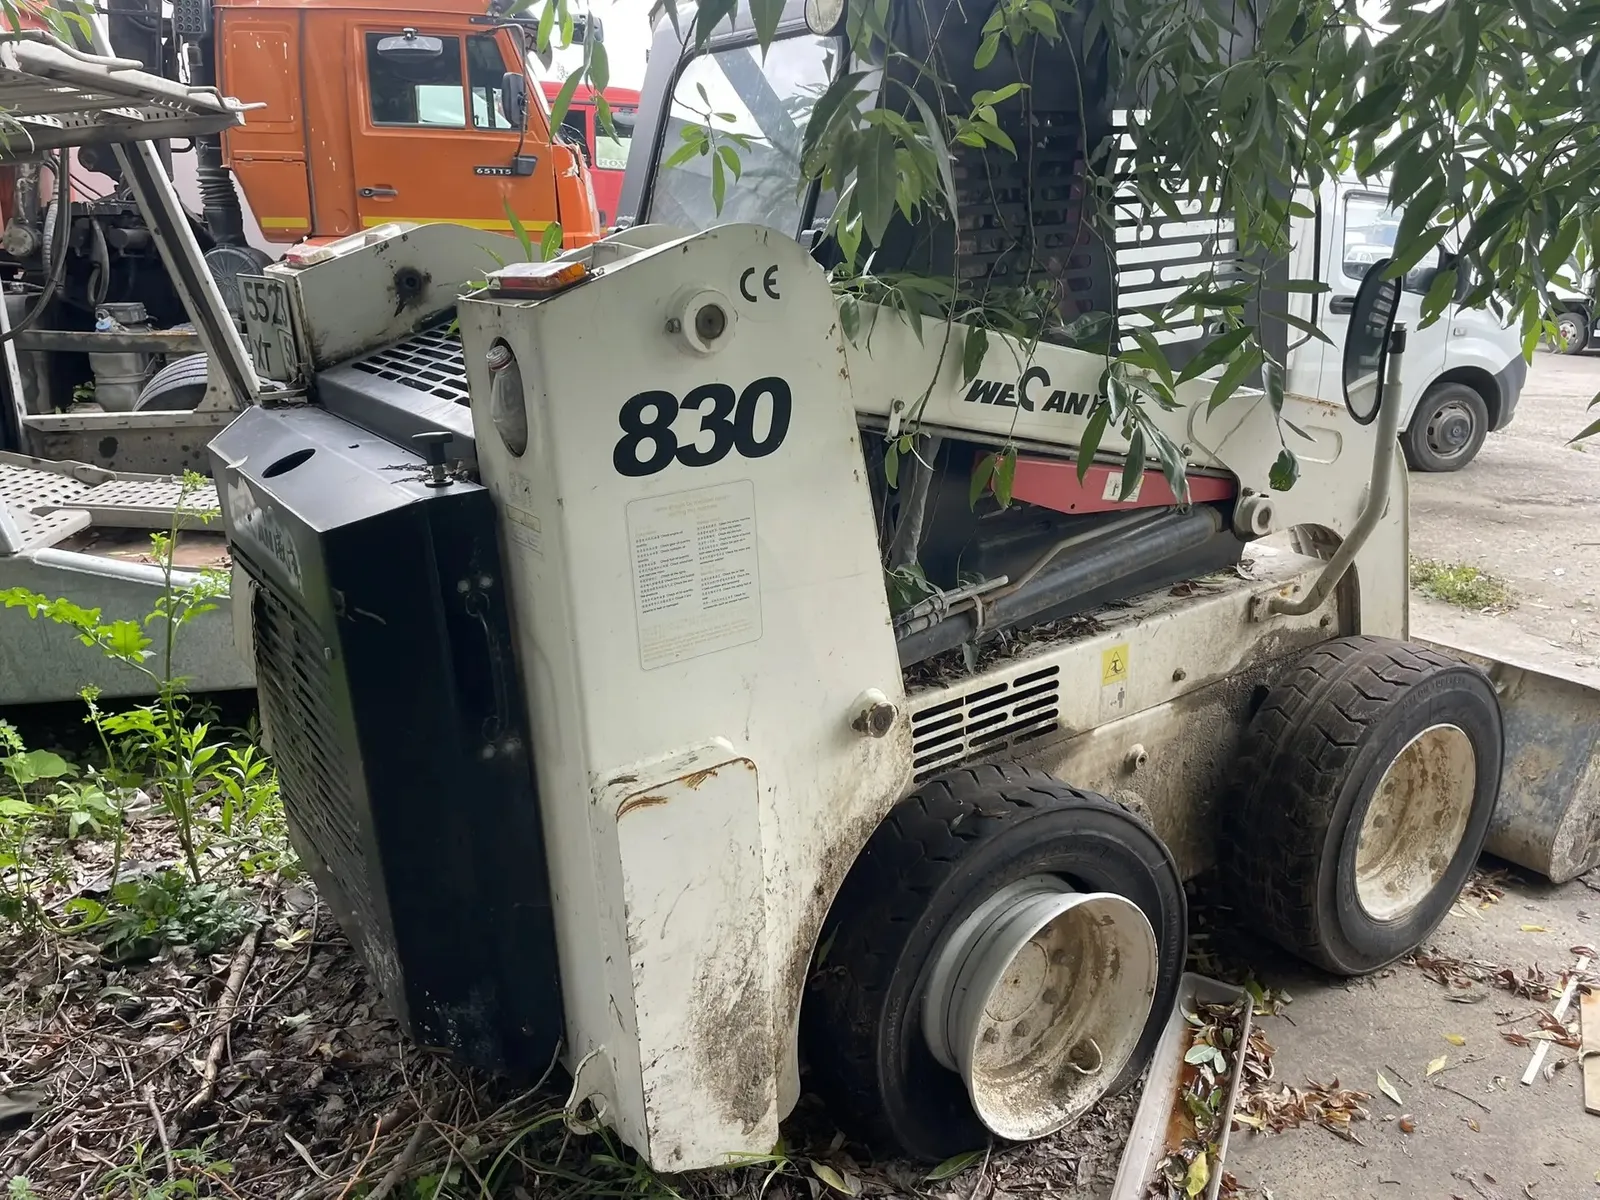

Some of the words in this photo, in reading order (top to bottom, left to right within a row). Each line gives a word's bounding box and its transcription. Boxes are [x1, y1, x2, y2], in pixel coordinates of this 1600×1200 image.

[476, 167, 512, 175] 65115
[739, 264, 781, 303] CE
[612, 376, 792, 477] 830
